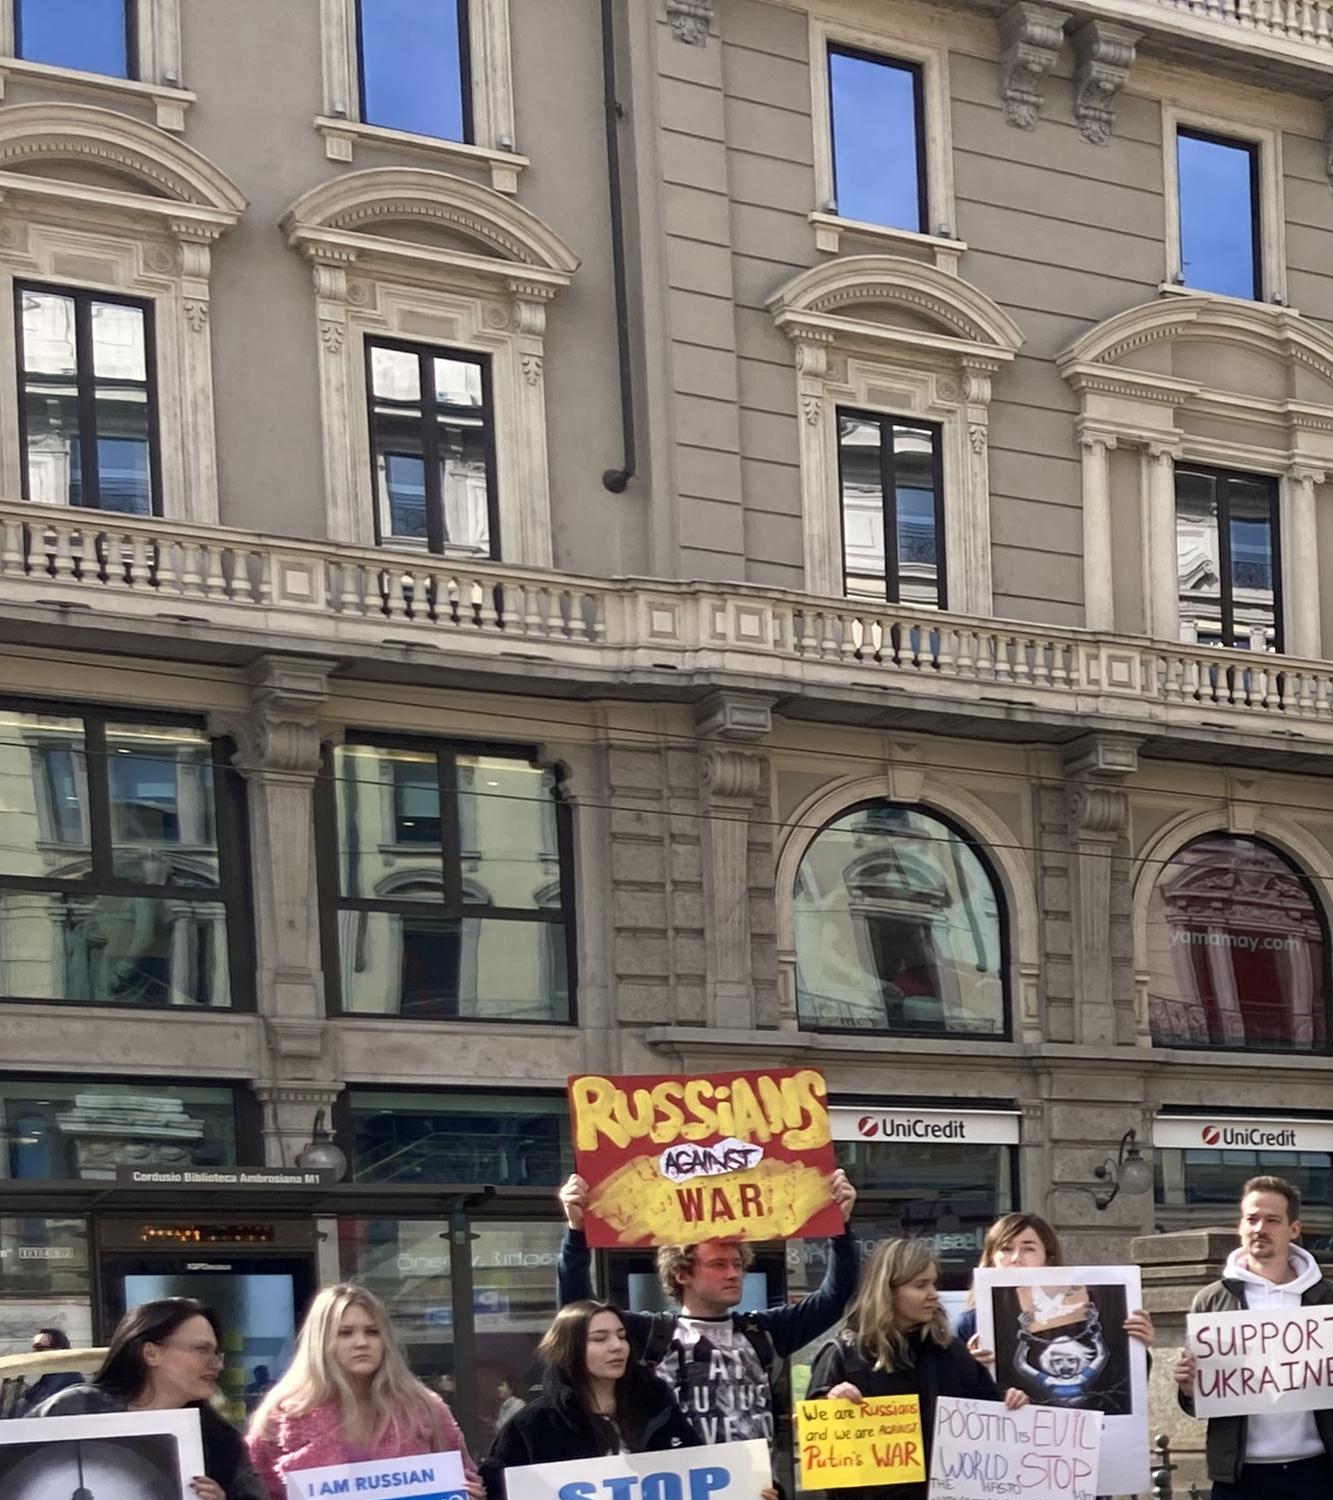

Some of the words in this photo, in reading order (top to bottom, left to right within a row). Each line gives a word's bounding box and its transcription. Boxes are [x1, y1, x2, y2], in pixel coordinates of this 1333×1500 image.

[1170, 931, 1300, 951] yamamay.com
[882, 1118, 966, 1140] UniCredit
[1223, 1126, 1297, 1147] UniCredit
[665, 1147, 758, 1174] AGAINST
[133, 1171, 181, 1183] Cordusio
[184, 1172, 237, 1183] Biblioteca
[240, 1173, 302, 1184] Ambrosiana
[305, 1174, 320, 1184] M1
[676, 1183, 765, 1222] WAR
[802, 1405, 829, 1421] We
[834, 1408, 856, 1419] are
[860, 1401, 917, 1418] Russians
[806, 1427, 828, 1441] and
[834, 1430, 851, 1440] we
[855, 1428, 874, 1439] are
[872, 1441, 921, 1467] WAR
[939, 1446, 1009, 1481] WORLD
[1016, 1452, 1092, 1490] STOP
[308, 1482, 314, 1497] I
[320, 1478, 350, 1496] AM
[355, 1468, 435, 1492] RUSSIAN
[930, 1477, 955, 1490] THE
